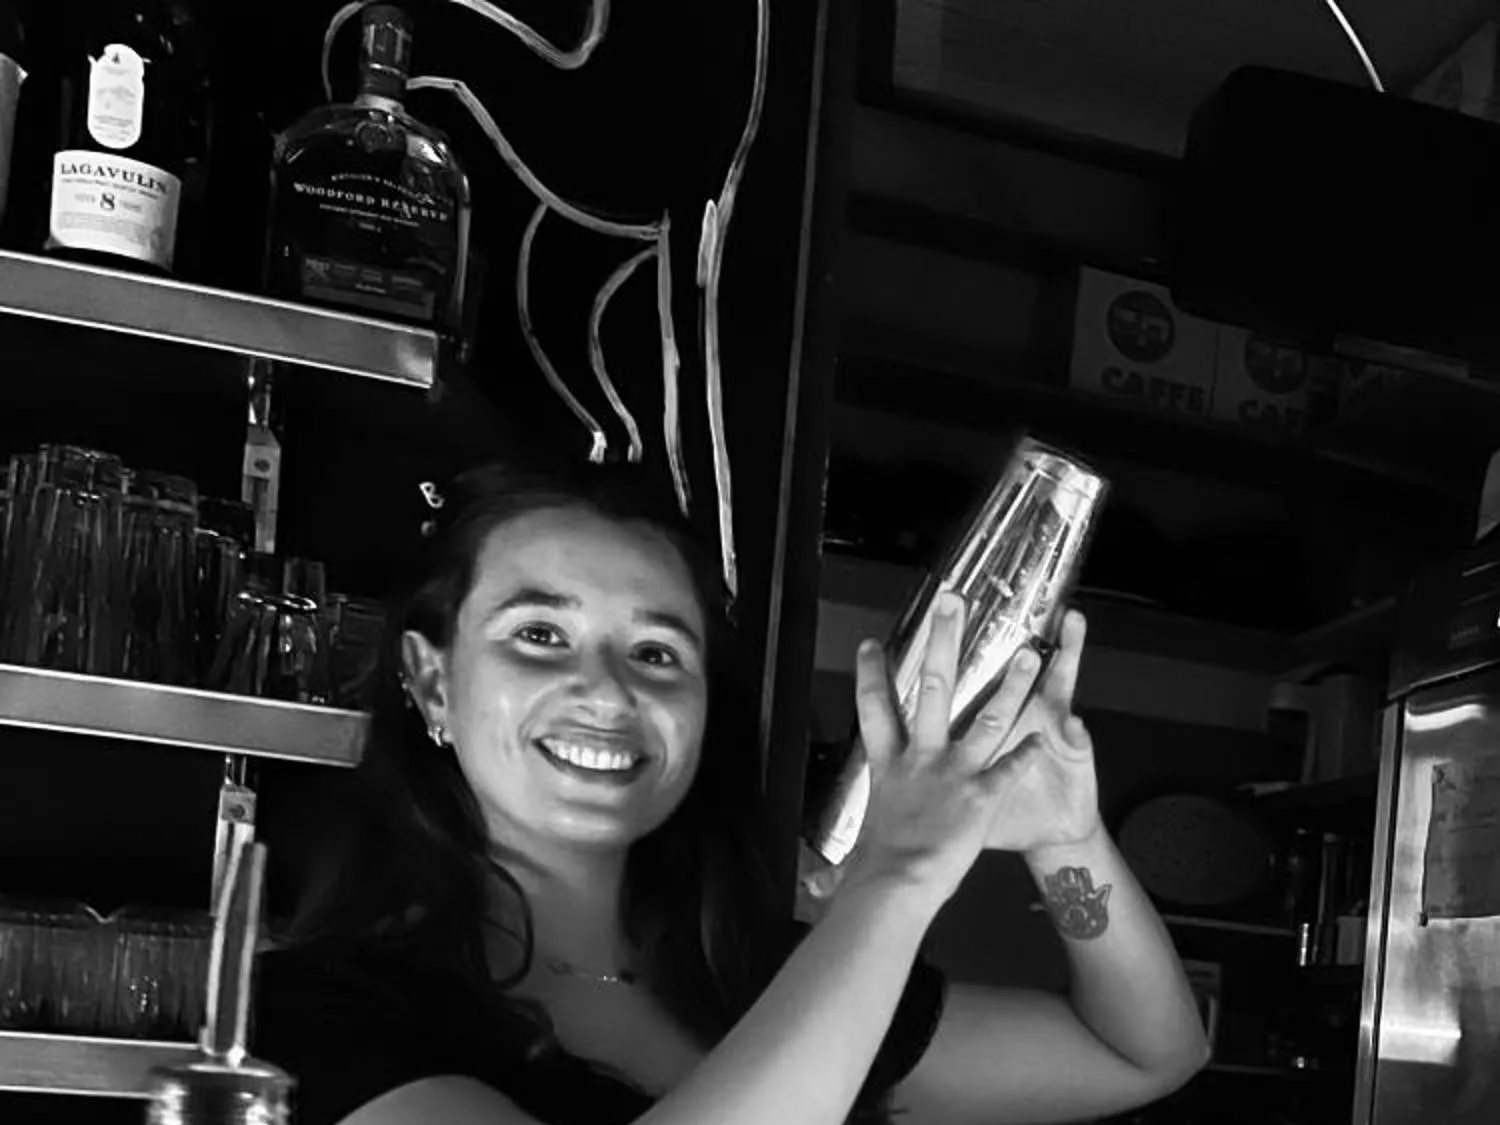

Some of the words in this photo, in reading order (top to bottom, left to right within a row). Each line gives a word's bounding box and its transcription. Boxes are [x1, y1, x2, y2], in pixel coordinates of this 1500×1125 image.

[60, 162, 168, 195] LAGAVULIN
[100, 192, 116, 211] 8
[293, 181, 376, 205] WOODFORD
